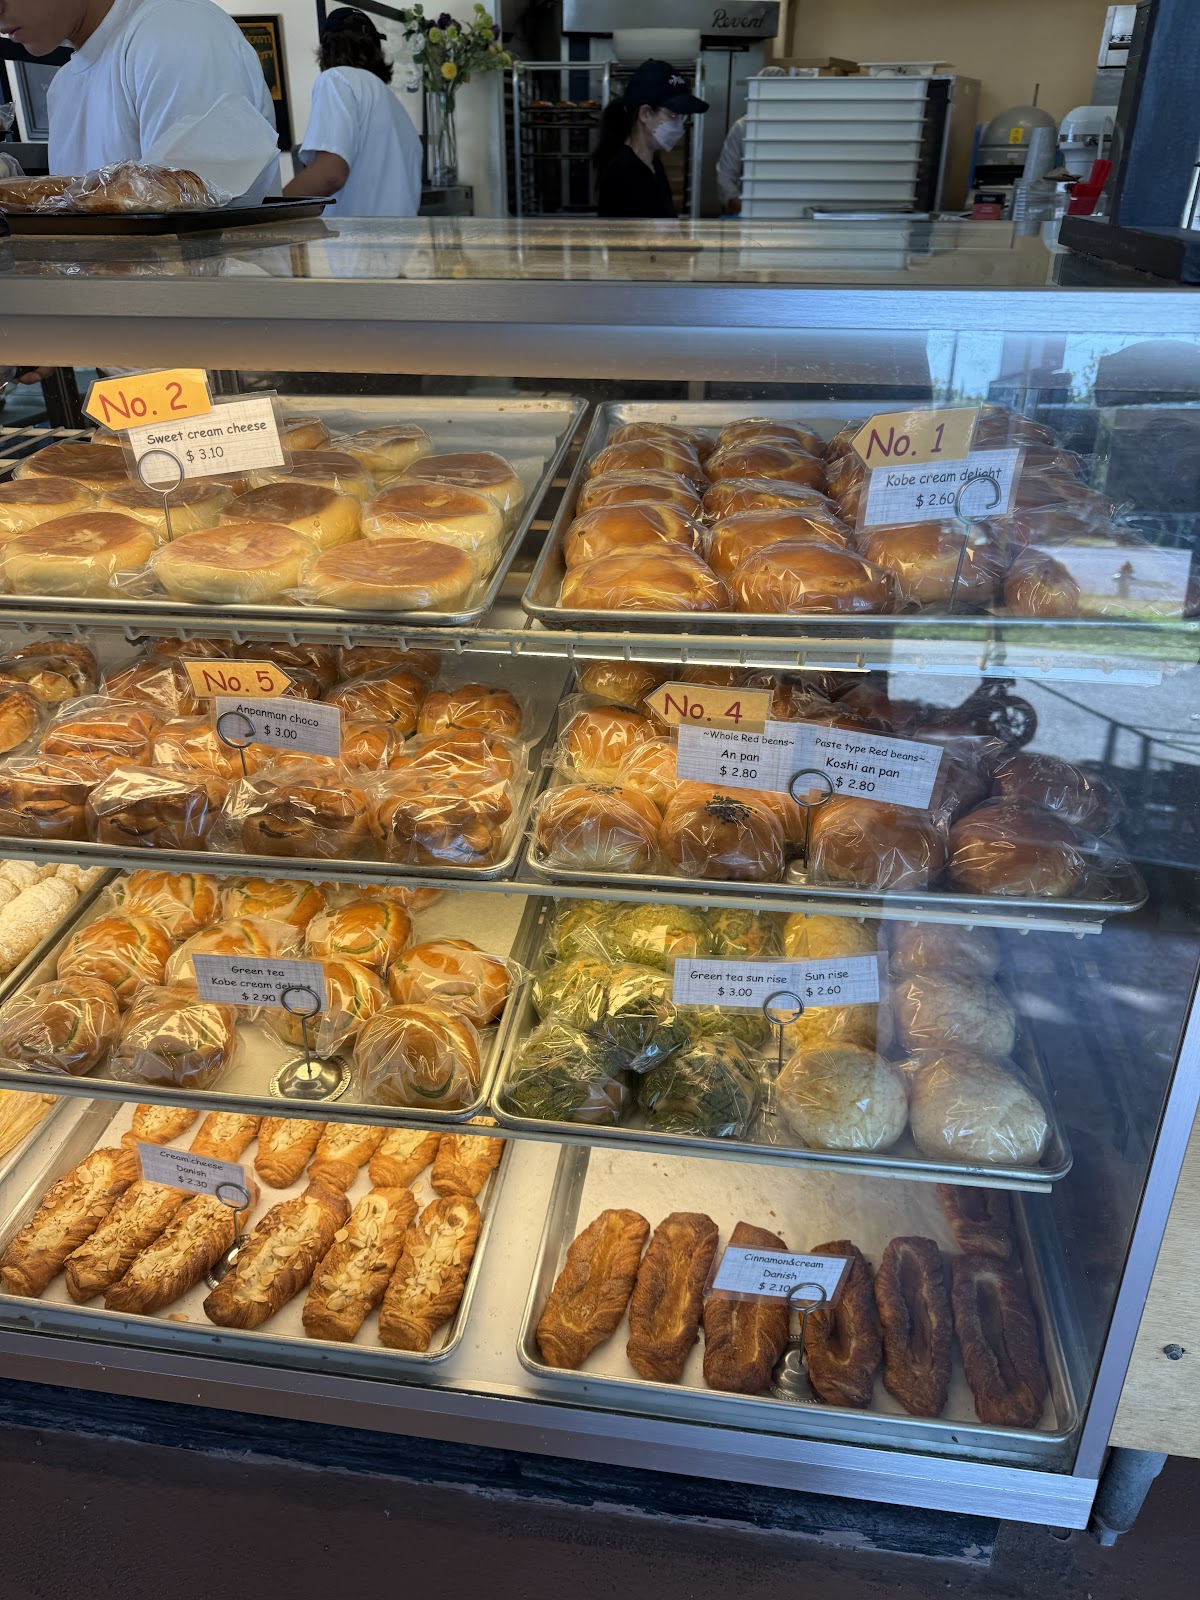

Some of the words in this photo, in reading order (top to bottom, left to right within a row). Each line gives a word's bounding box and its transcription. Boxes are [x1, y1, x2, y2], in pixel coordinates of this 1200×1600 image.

[712, 8, 768, 28] Revent
[98, 390, 158, 423] No.
[165, 381, 188, 411] 2
[147, 431, 184, 445] Sweet
[187, 428, 224, 440] cream
[226, 420, 268, 435] cheese
[865, 426, 917, 460] No.
[930, 423, 945, 453] 1
[185, 450, 195, 463] $
[200, 446, 224, 460] 3.10
[886, 473, 916, 488] Kobe
[920, 472, 956, 484] cream
[915, 493, 924, 508] $
[928, 492, 955, 506] 2.60
[202, 669, 250, 693] No.
[255, 670, 275, 693] 5
[236, 704, 287, 721] Anpanman
[289, 713, 319, 727] choco
[664, 693, 712, 722] No.
[724, 701, 743, 724] 4
[263, 724, 271, 737] $
[275, 726, 298, 740] 3.00
[741, 733, 759, 744] Red
[815, 738, 842, 751] Paste
[844, 742, 867, 755] type
[869, 746, 889, 758] Red
[721, 748, 736, 760] An
[740, 752, 760, 765] pan
[719, 765, 727, 777] $
[732, 767, 758, 779] 2.80
[825, 756, 859, 771] Koshi
[861, 764, 876, 774] an
[878, 767, 900, 781] pan
[835, 776, 843, 789] $
[848, 778, 876, 792] 2.80
[231, 965, 263, 976] Green
[267, 968, 285, 977] tea
[690, 970, 722, 981] Green
[725, 973, 743, 982] tea
[746, 974, 764, 983] sun
[766, 974, 787, 984] rise
[804, 972, 825, 981] Sun
[827, 970, 849, 979] rise
[211, 977, 238, 986] Kobe
[240, 981, 272, 989] cream
[805, 987, 813, 997] $
[817, 985, 841, 996] 2.60
[241, 992, 249, 1001] $
[253, 993, 276, 1002] 2.90
[717, 987, 725, 997] $
[729, 987, 753, 997] 3.00
[160, 1150, 189, 1163] Cream
[191, 1158, 223, 1171] cheese
[176, 1164, 207, 1177] Danish
[178, 1175, 184, 1184] $
[187, 1177, 208, 1188] 2.30
[744, 1253, 824, 1269] Cinnamon&cream
[763, 1269, 798, 1280] Danish
[758, 1282, 766, 1291] $
[769, 1284, 791, 1293] 2.10
